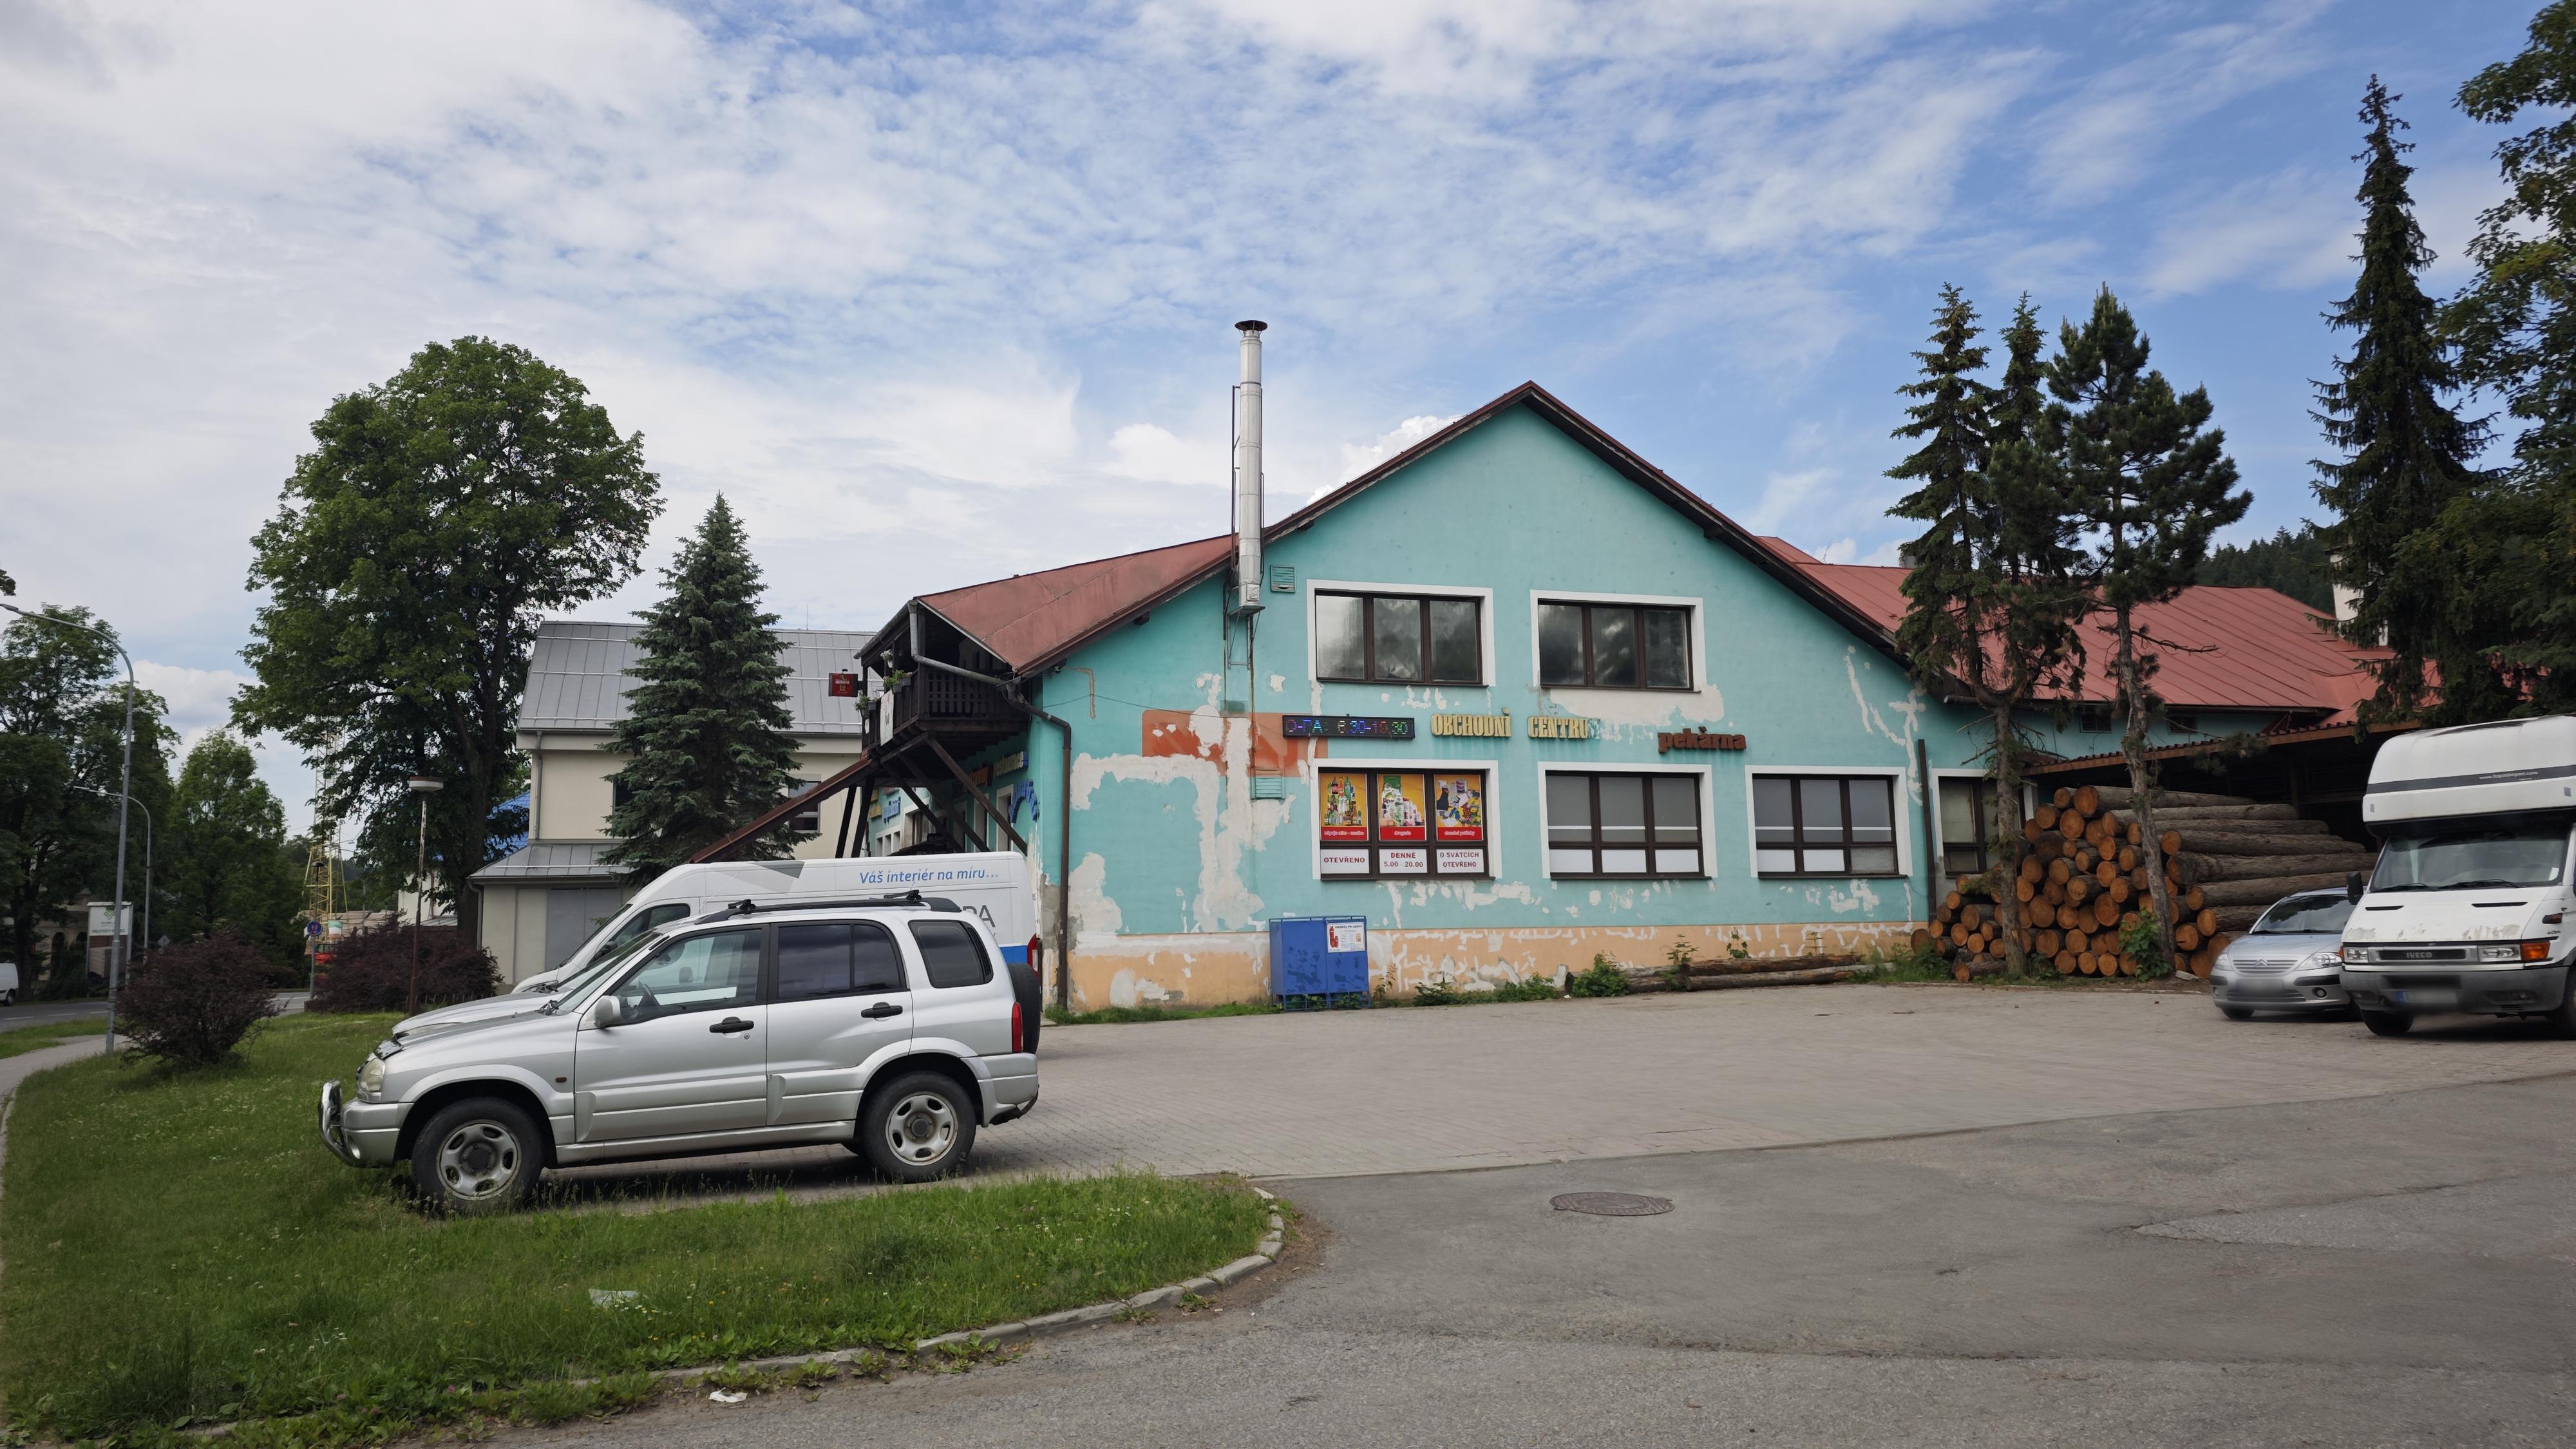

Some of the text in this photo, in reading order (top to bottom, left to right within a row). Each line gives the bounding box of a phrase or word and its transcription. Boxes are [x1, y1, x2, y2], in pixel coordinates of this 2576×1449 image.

[1431, 708, 1511, 737] OBCHODNÍ
[1658, 726, 1747, 753] pekárna
[860, 867, 999, 884] Váš interiér na míru...
